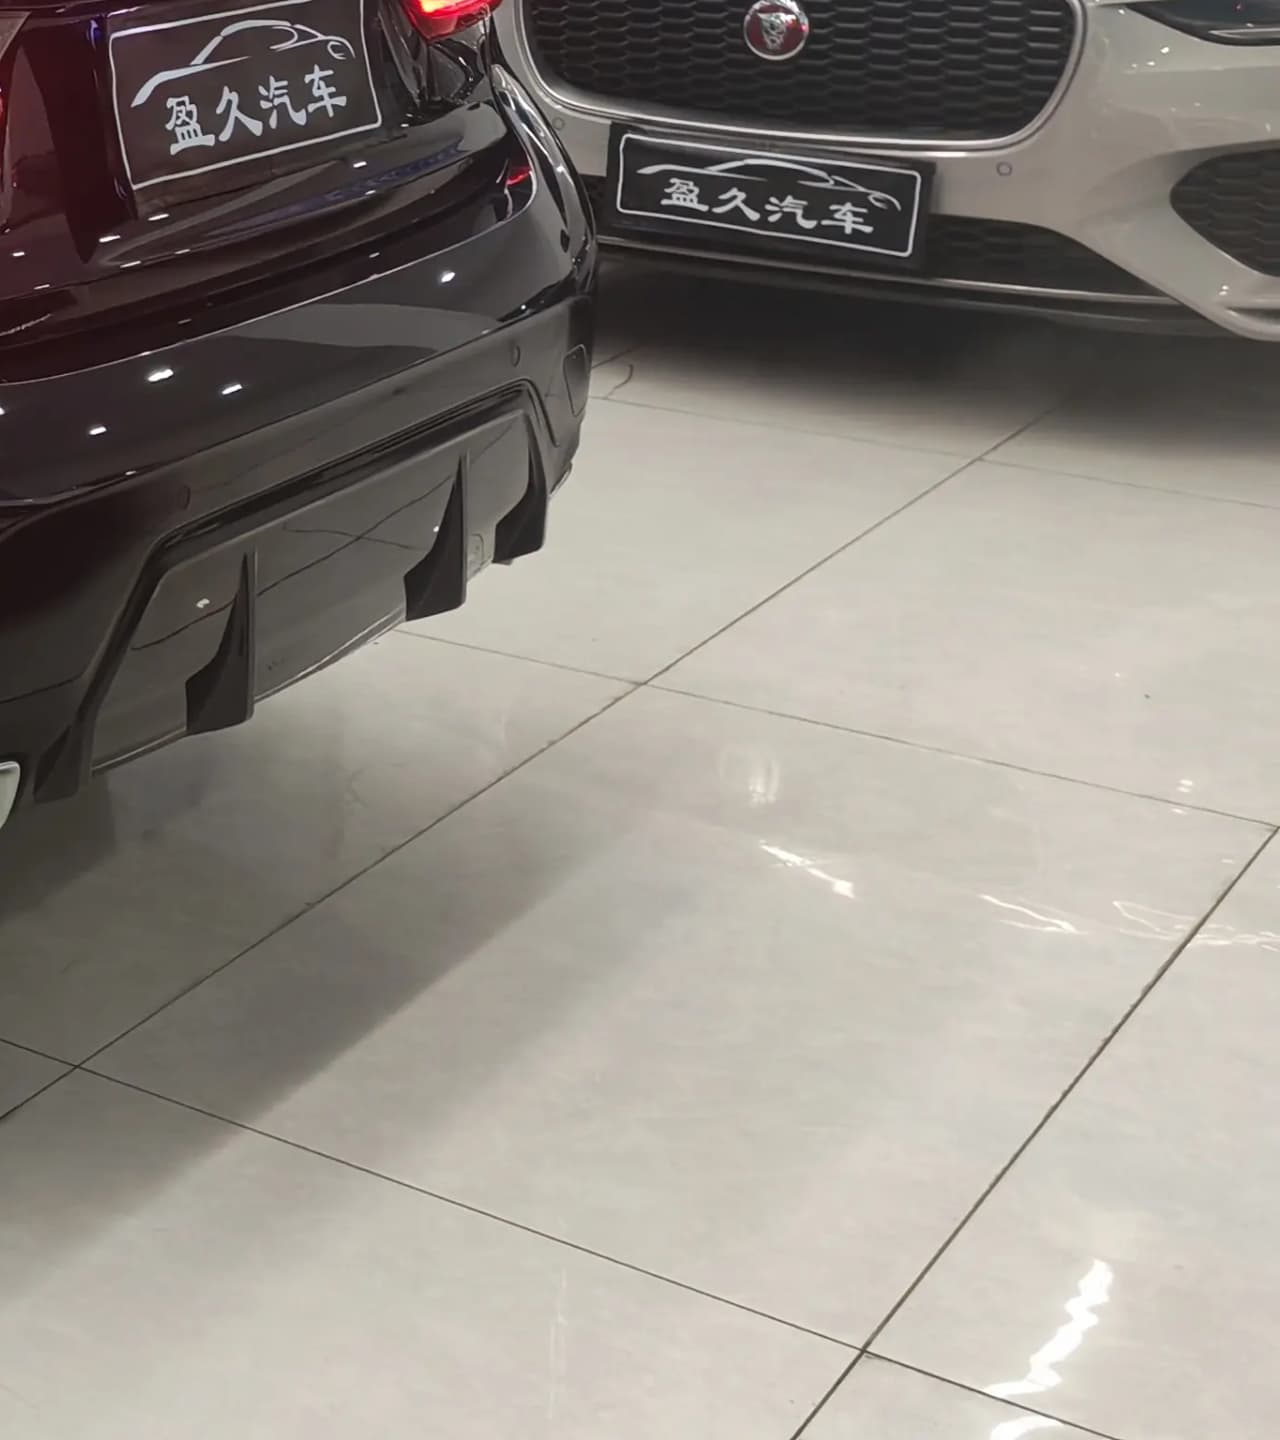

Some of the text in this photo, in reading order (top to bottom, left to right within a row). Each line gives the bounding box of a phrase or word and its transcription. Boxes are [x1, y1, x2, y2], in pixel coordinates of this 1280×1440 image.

[166, 64, 347, 156] 盈久汽车
[660, 177, 875, 235] 盈久汽车
